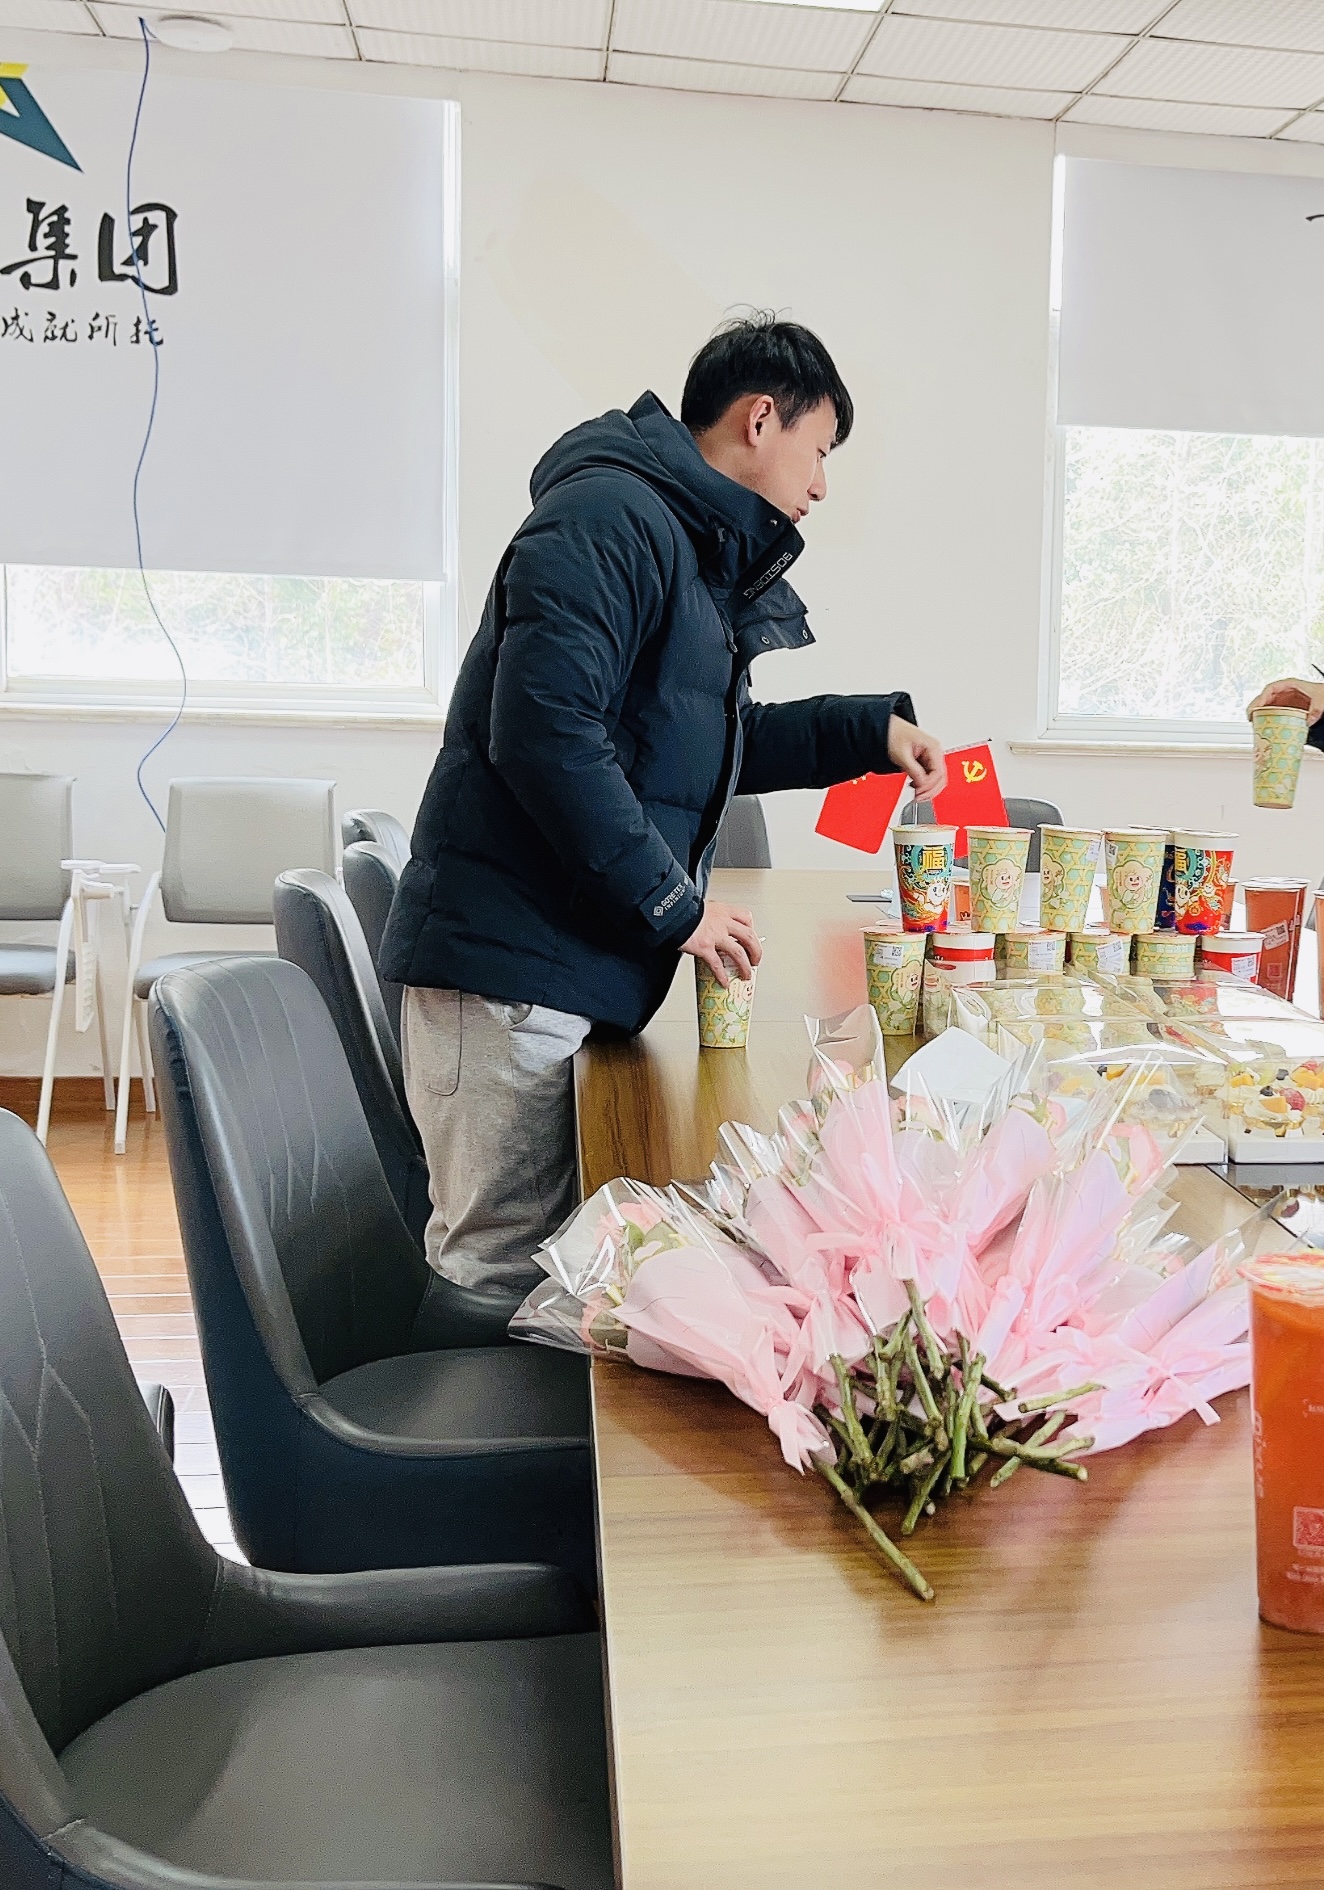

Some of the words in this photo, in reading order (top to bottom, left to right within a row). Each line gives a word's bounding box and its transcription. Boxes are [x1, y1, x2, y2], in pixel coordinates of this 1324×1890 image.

[0, 197, 179, 296] 集团
[1, 307, 164, 347] 成就所托
[742, 551, 794, 600] BOSIDENG
[921, 845, 945, 870] 福
